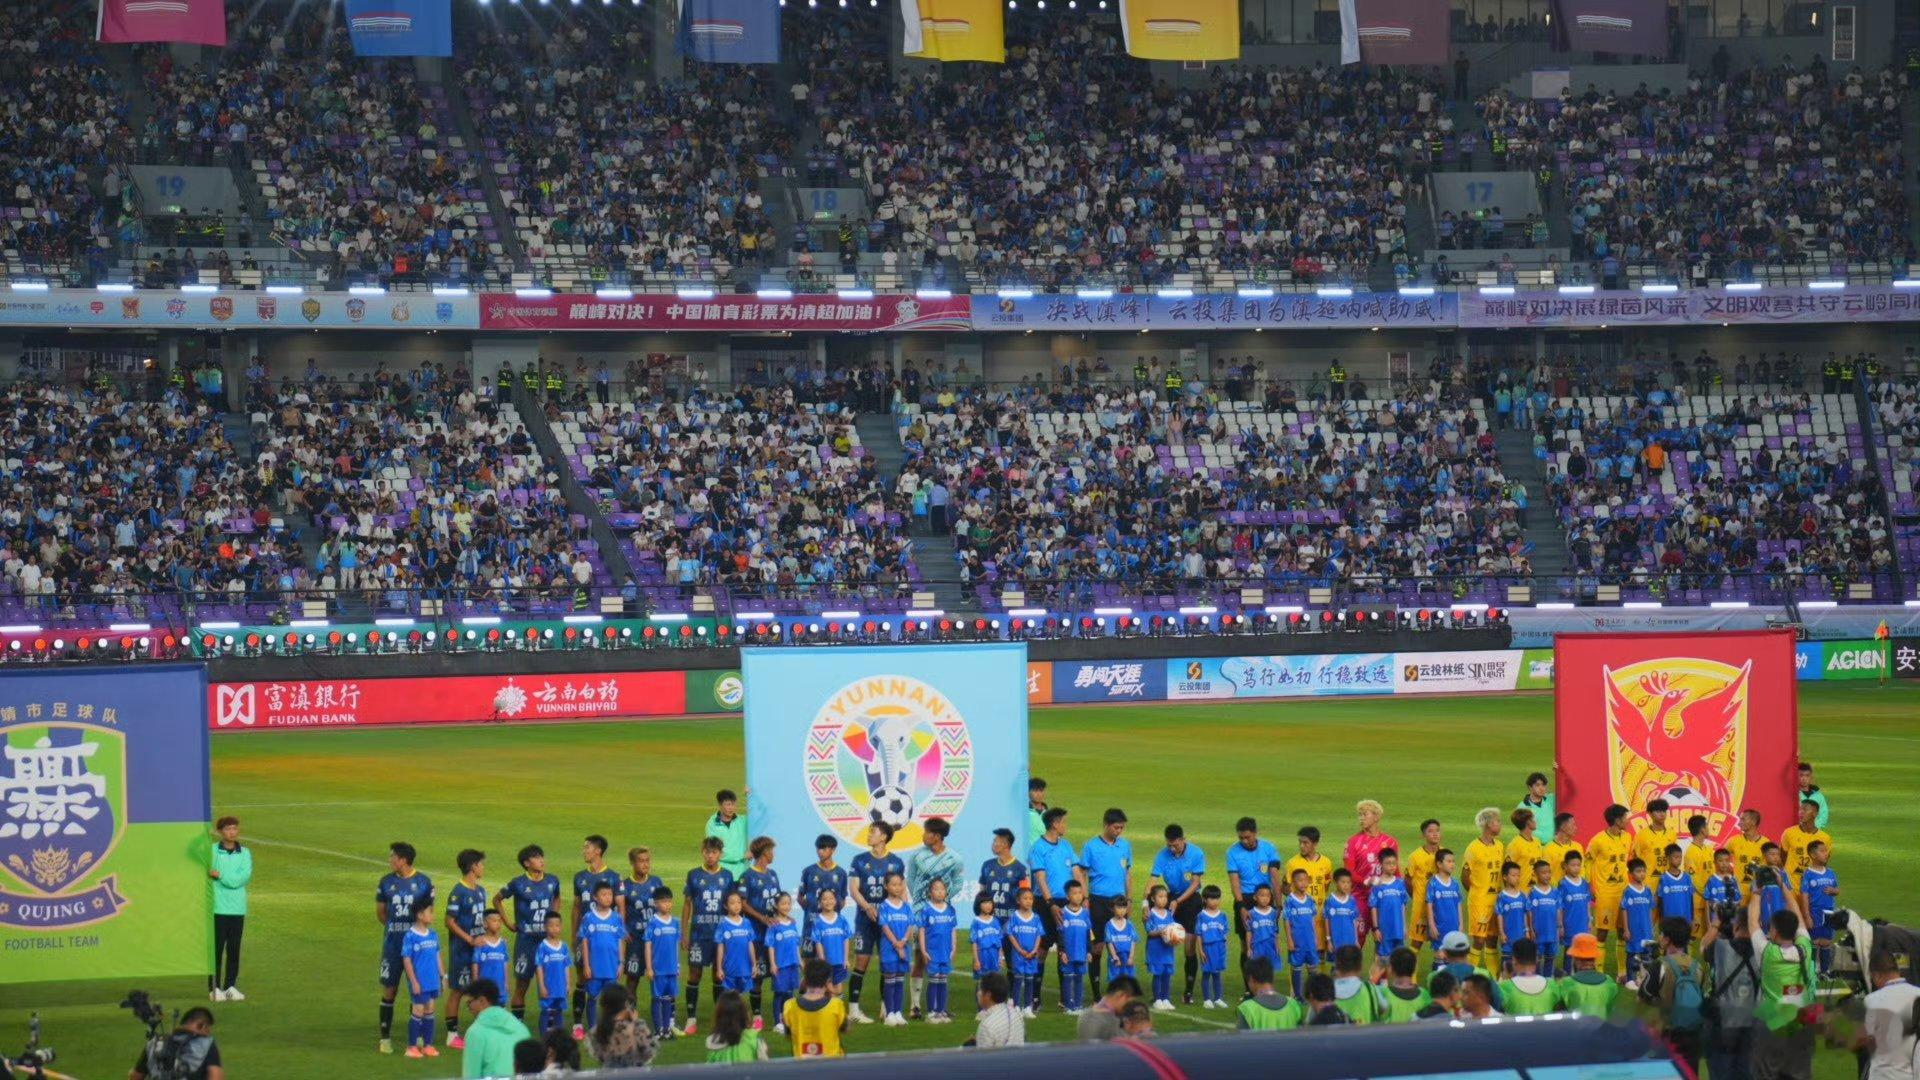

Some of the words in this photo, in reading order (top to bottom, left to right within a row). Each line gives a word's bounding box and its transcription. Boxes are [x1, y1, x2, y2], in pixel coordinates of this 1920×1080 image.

[155, 175, 187, 196] 19
[1465, 182, 1494, 203] 17
[811, 191, 839, 211] 18
[1703, 293, 1920, 314] 文明观赛共守云岭同
[1897, 646, 1920, 672] 安
[1242, 667, 1311, 687] 笃行如初
[1318, 664, 1390, 684] 行稳致远
[1420, 663, 1465, 676] 云投林纸
[532, 680, 619, 702] 云南白药
[1179, 682, 1211, 690] 云投集团
[830, 679, 945, 716] YUNNAN
[536, 703, 577, 713] YUNNAN
[578, 701, 617, 711] BAIYAO
[269, 714, 319, 725] FUDIAN
[321, 713, 356, 723] BANK
[1490, 871, 1500, 881] 77
[869, 886, 883, 897] 33
[993, 891, 1006, 904] 66
[18, 901, 86, 920] QUJING
[706, 900, 719, 911] 35
[533, 909, 547, 922] 47
[1602, 915, 1609, 925] 6
[5, 937, 64, 950] FOOTBALL
[69, 935, 99, 947] TEAM
[689, 951, 702, 962] 35
[515, 959, 527, 974] 47
[627, 961, 639, 973] 10
